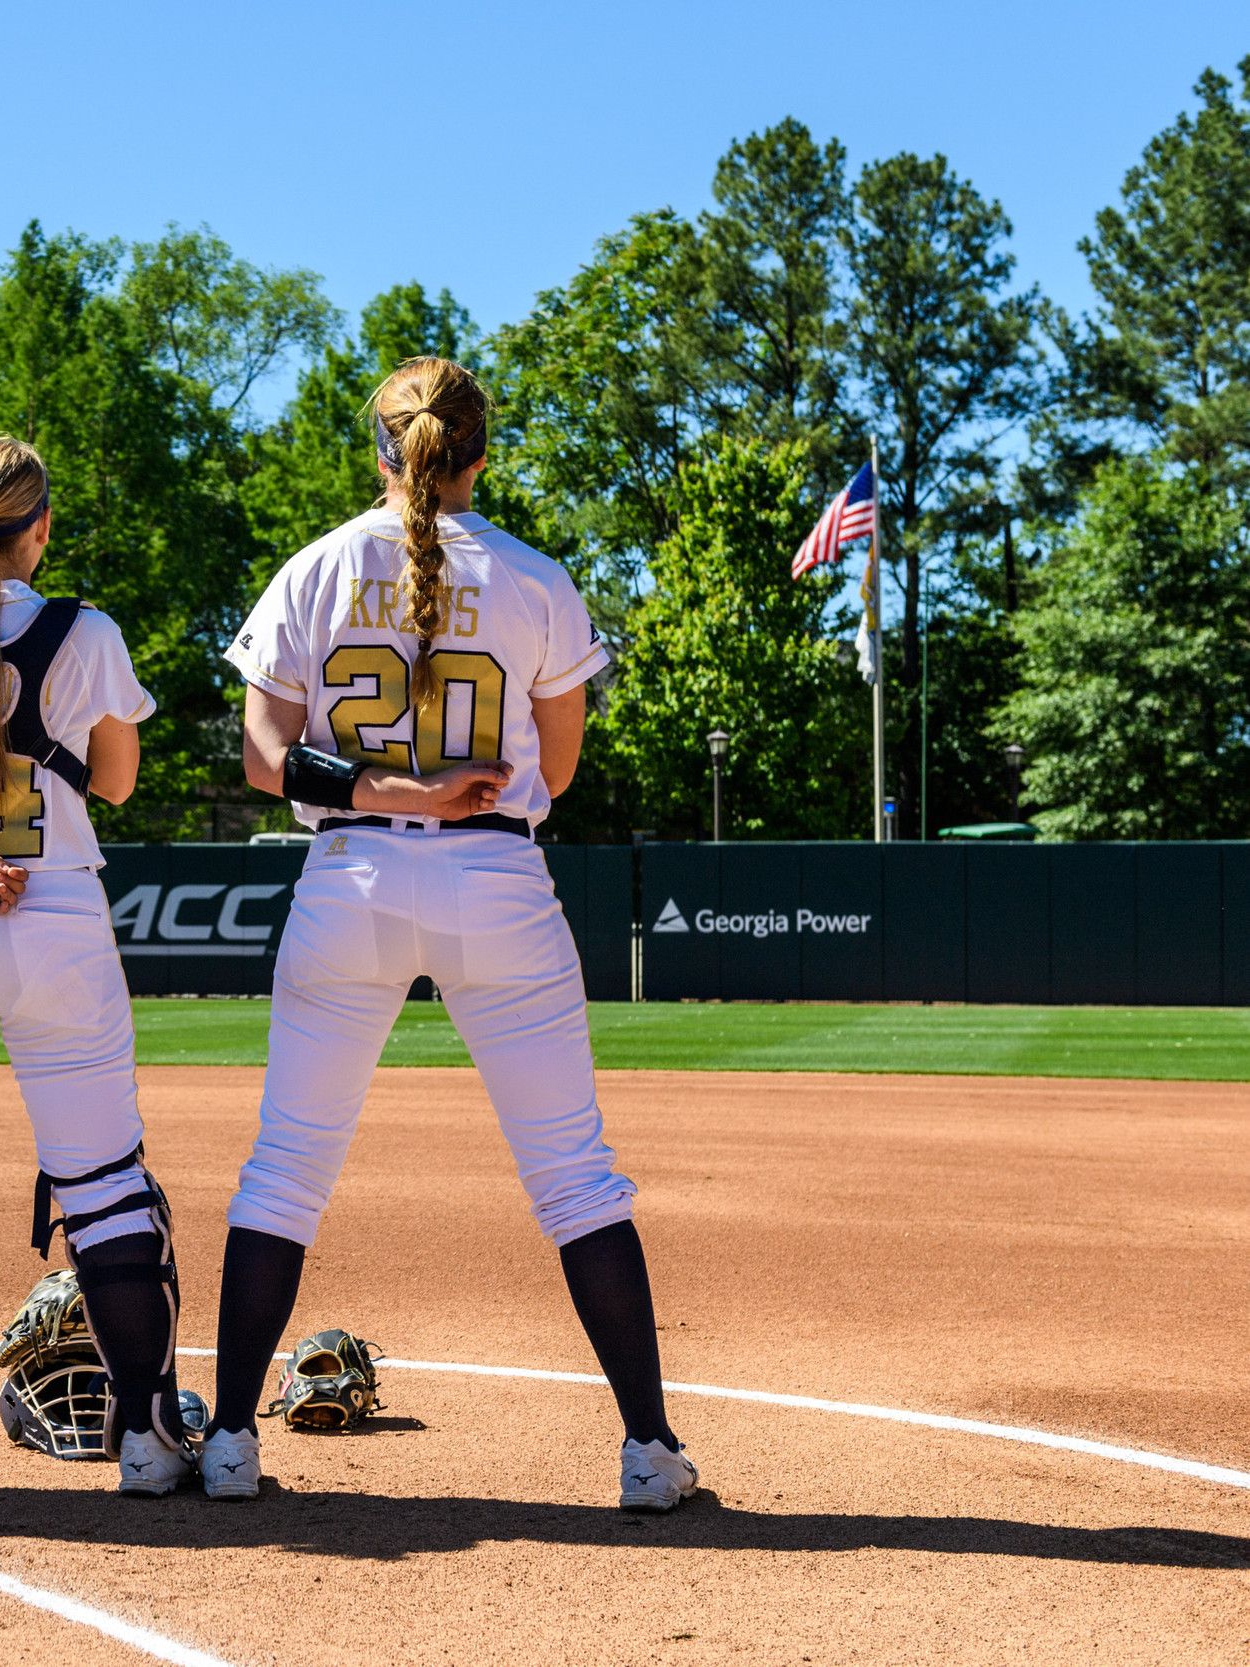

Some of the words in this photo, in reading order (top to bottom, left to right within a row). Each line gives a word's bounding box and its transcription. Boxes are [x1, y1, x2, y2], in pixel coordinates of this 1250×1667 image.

[348, 578, 481, 638] KRUS
[322, 644, 507, 776] 20
[110, 884, 288, 940] ACC
[695, 908, 789, 938] Georgia
[796, 908, 872, 933] Power
